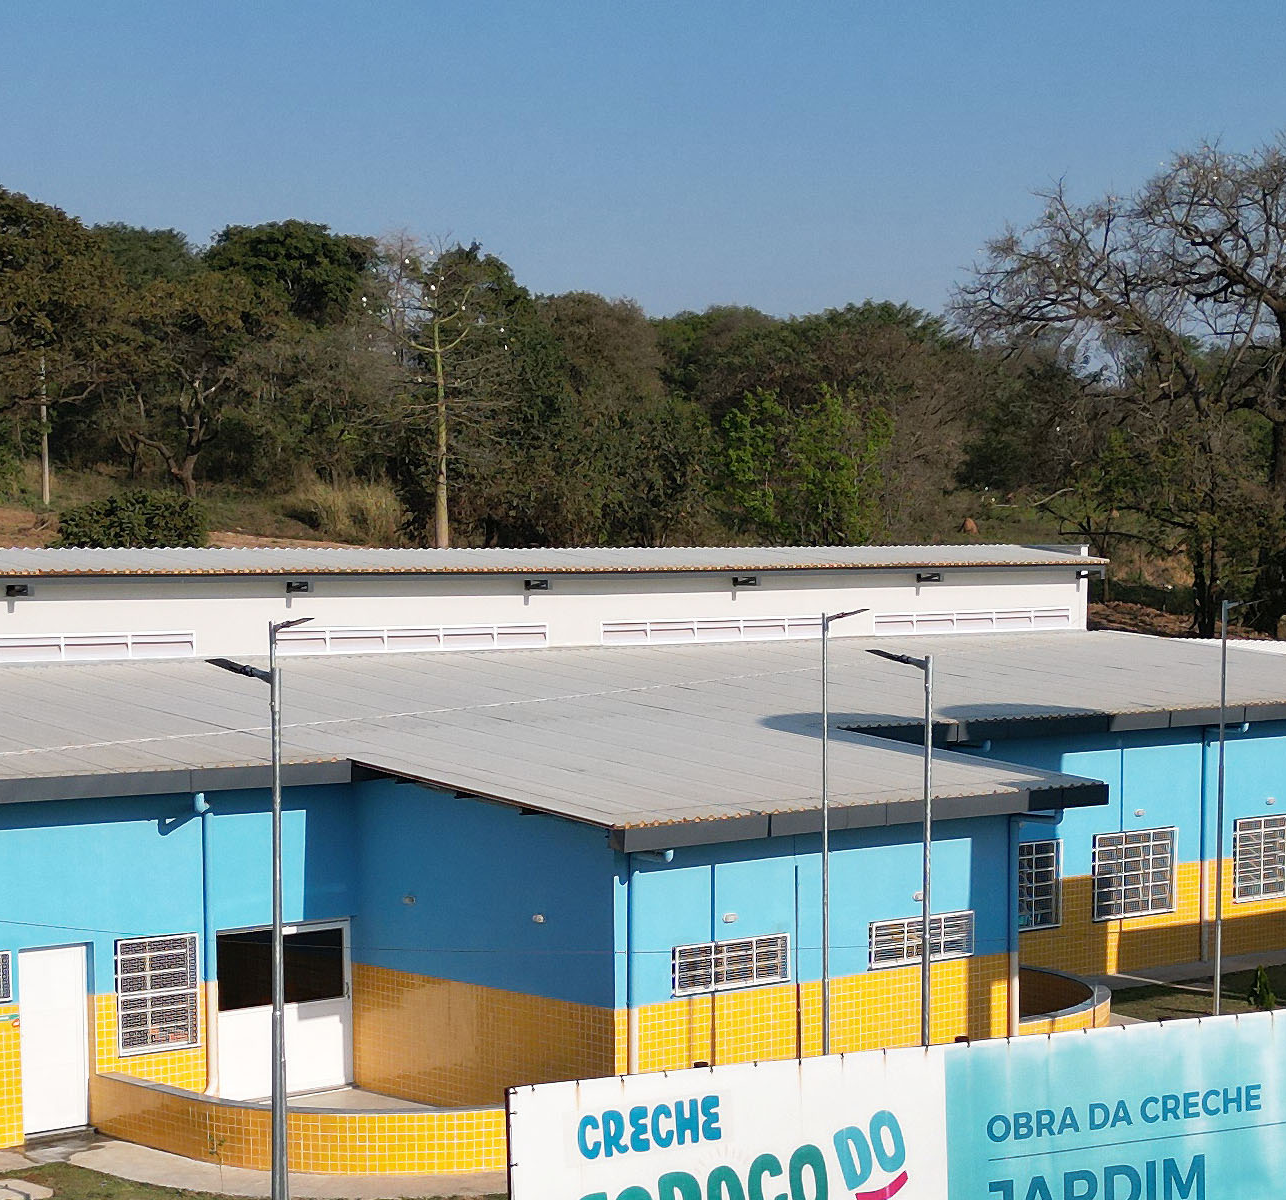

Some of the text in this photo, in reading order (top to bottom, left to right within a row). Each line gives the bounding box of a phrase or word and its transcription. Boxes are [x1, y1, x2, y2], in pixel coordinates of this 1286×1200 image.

[577, 1095, 722, 1160] CRECHE
[986, 1084, 1262, 1142] OBRA DA CRECHE
[833, 1109, 906, 1191] DO
